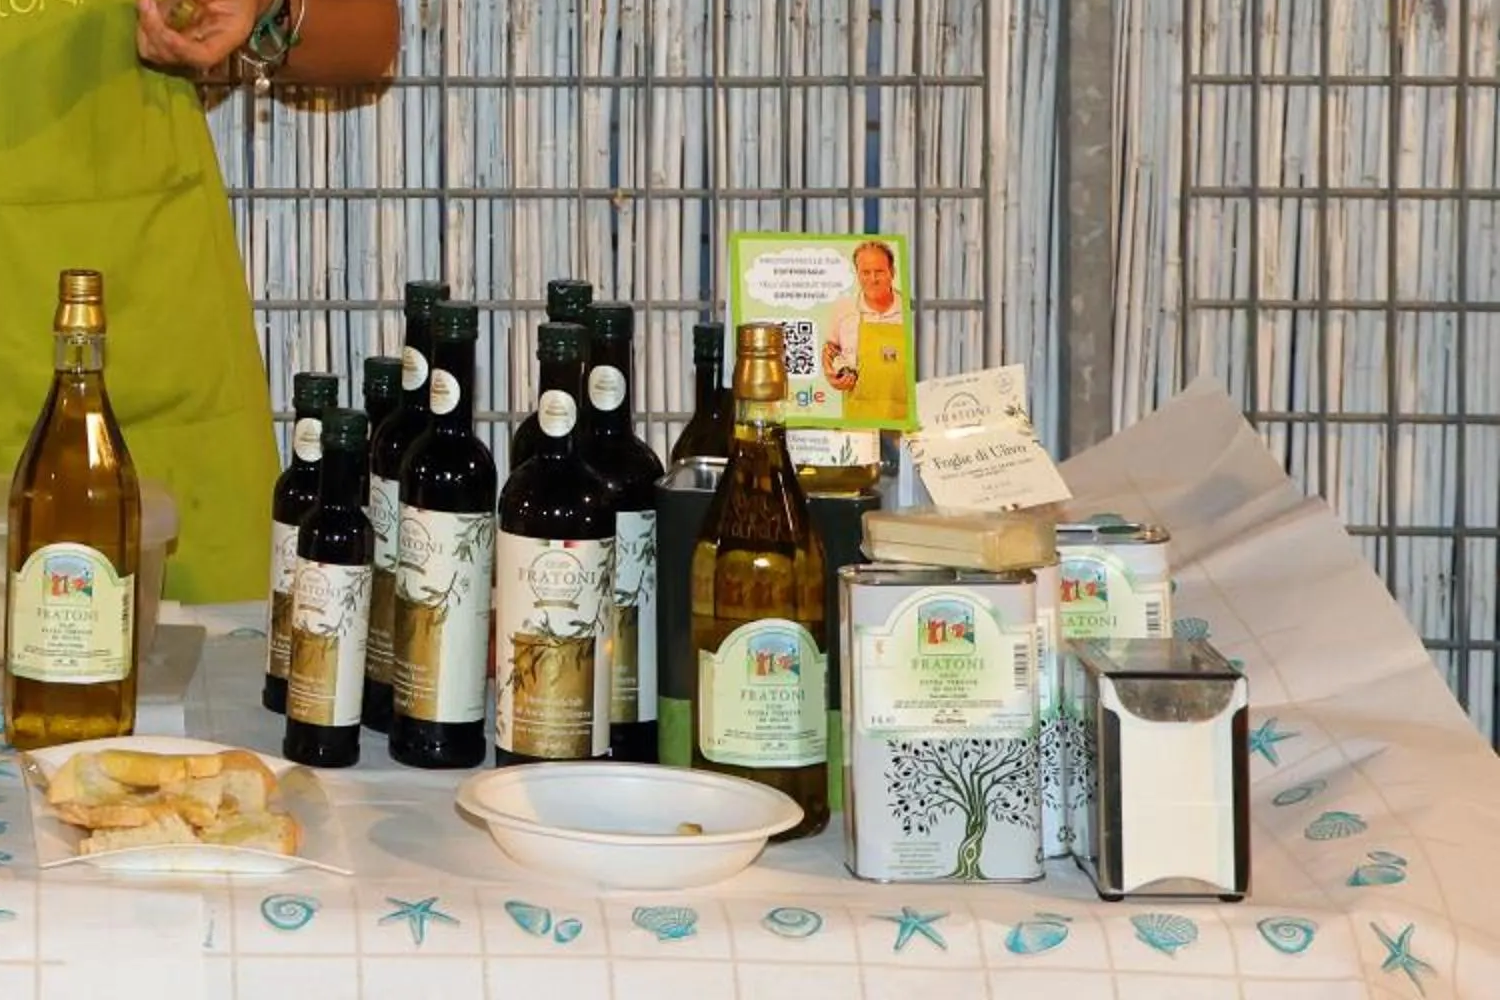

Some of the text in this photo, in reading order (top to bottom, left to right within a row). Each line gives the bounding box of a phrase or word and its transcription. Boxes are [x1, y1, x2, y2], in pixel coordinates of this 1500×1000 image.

[788, 384, 826, 407] ogle
[518, 567, 596, 585] FRATONI
[37, 606, 100, 622] FRATONI
[1061, 615, 1117, 628] ATONI
[910, 658, 985, 670] FRATONI
[740, 688, 805, 701] FRATONI
